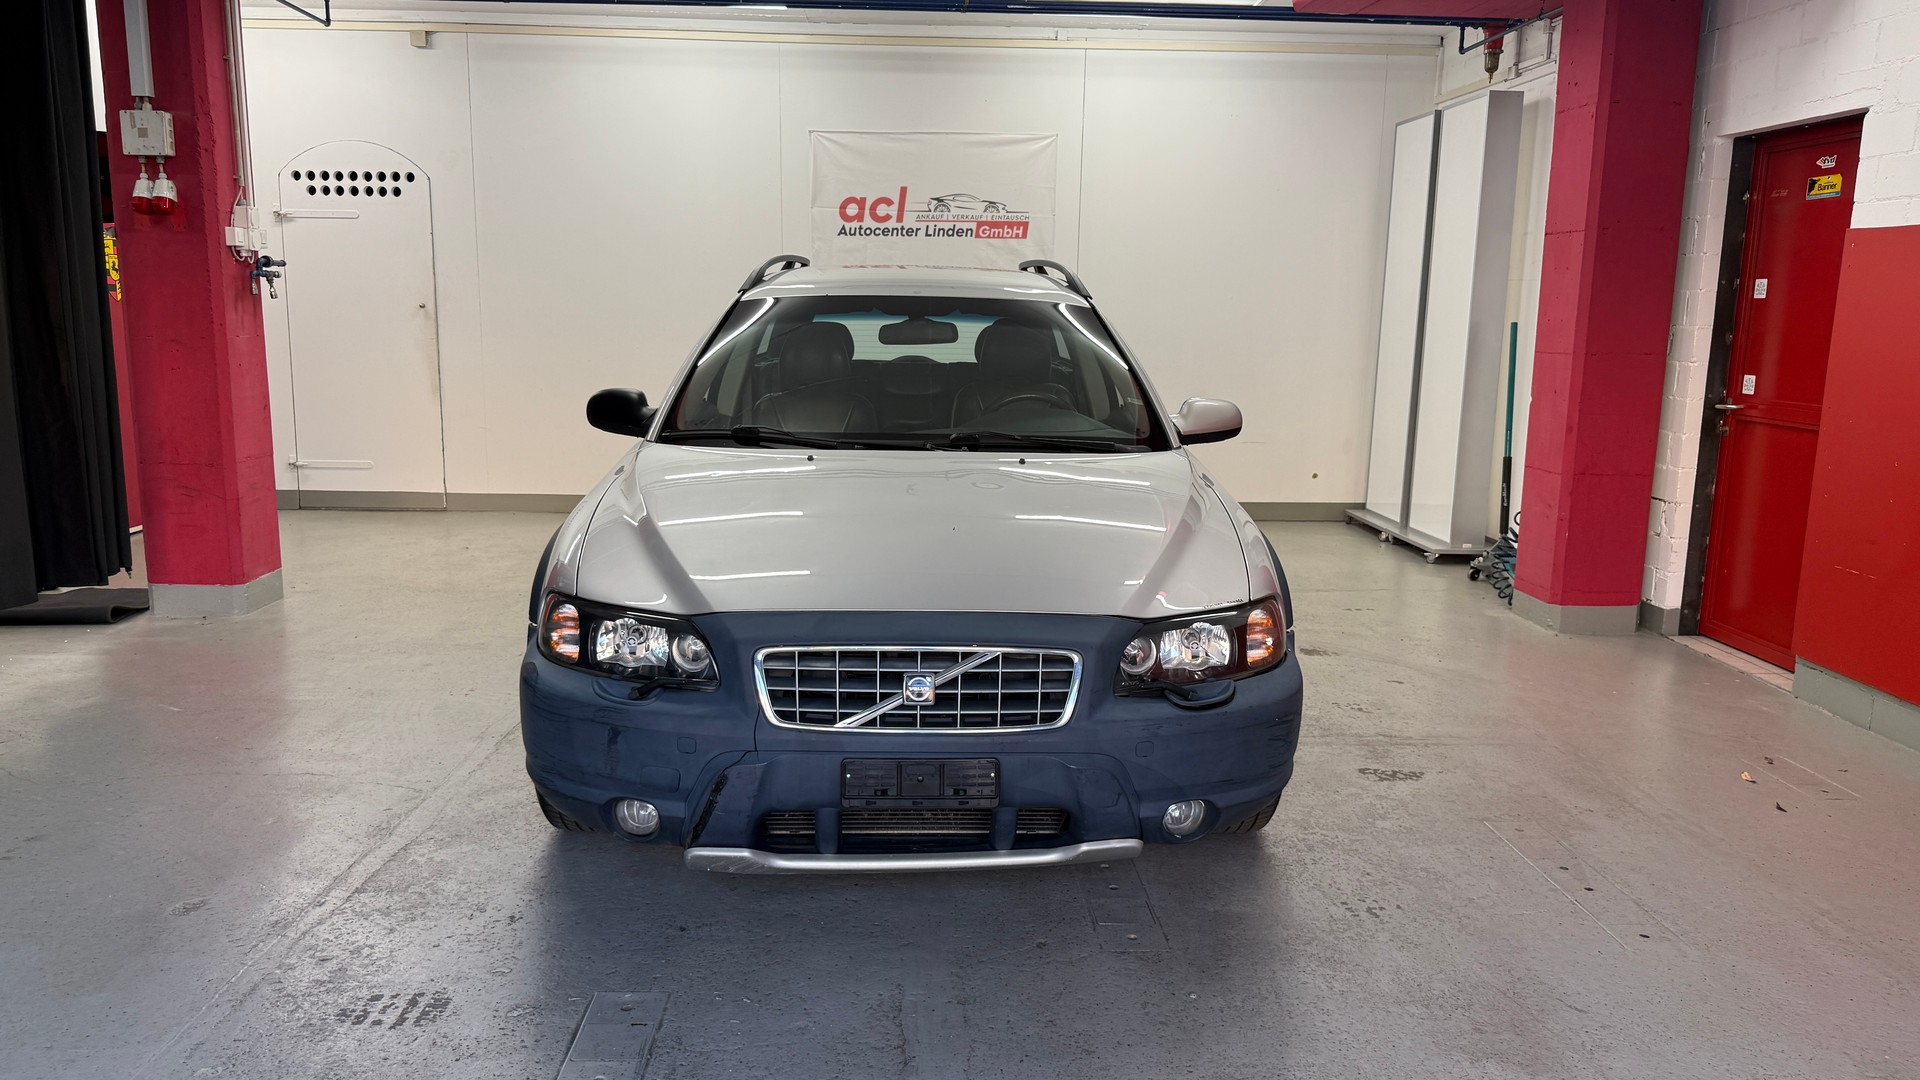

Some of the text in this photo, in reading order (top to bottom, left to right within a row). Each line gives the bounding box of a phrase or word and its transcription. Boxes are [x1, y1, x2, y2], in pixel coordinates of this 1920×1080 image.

[1818, 183, 1837, 191] Banner
[839, 186, 908, 223] acl
[837, 224, 1023, 238] Autocenter Linden GmbH
